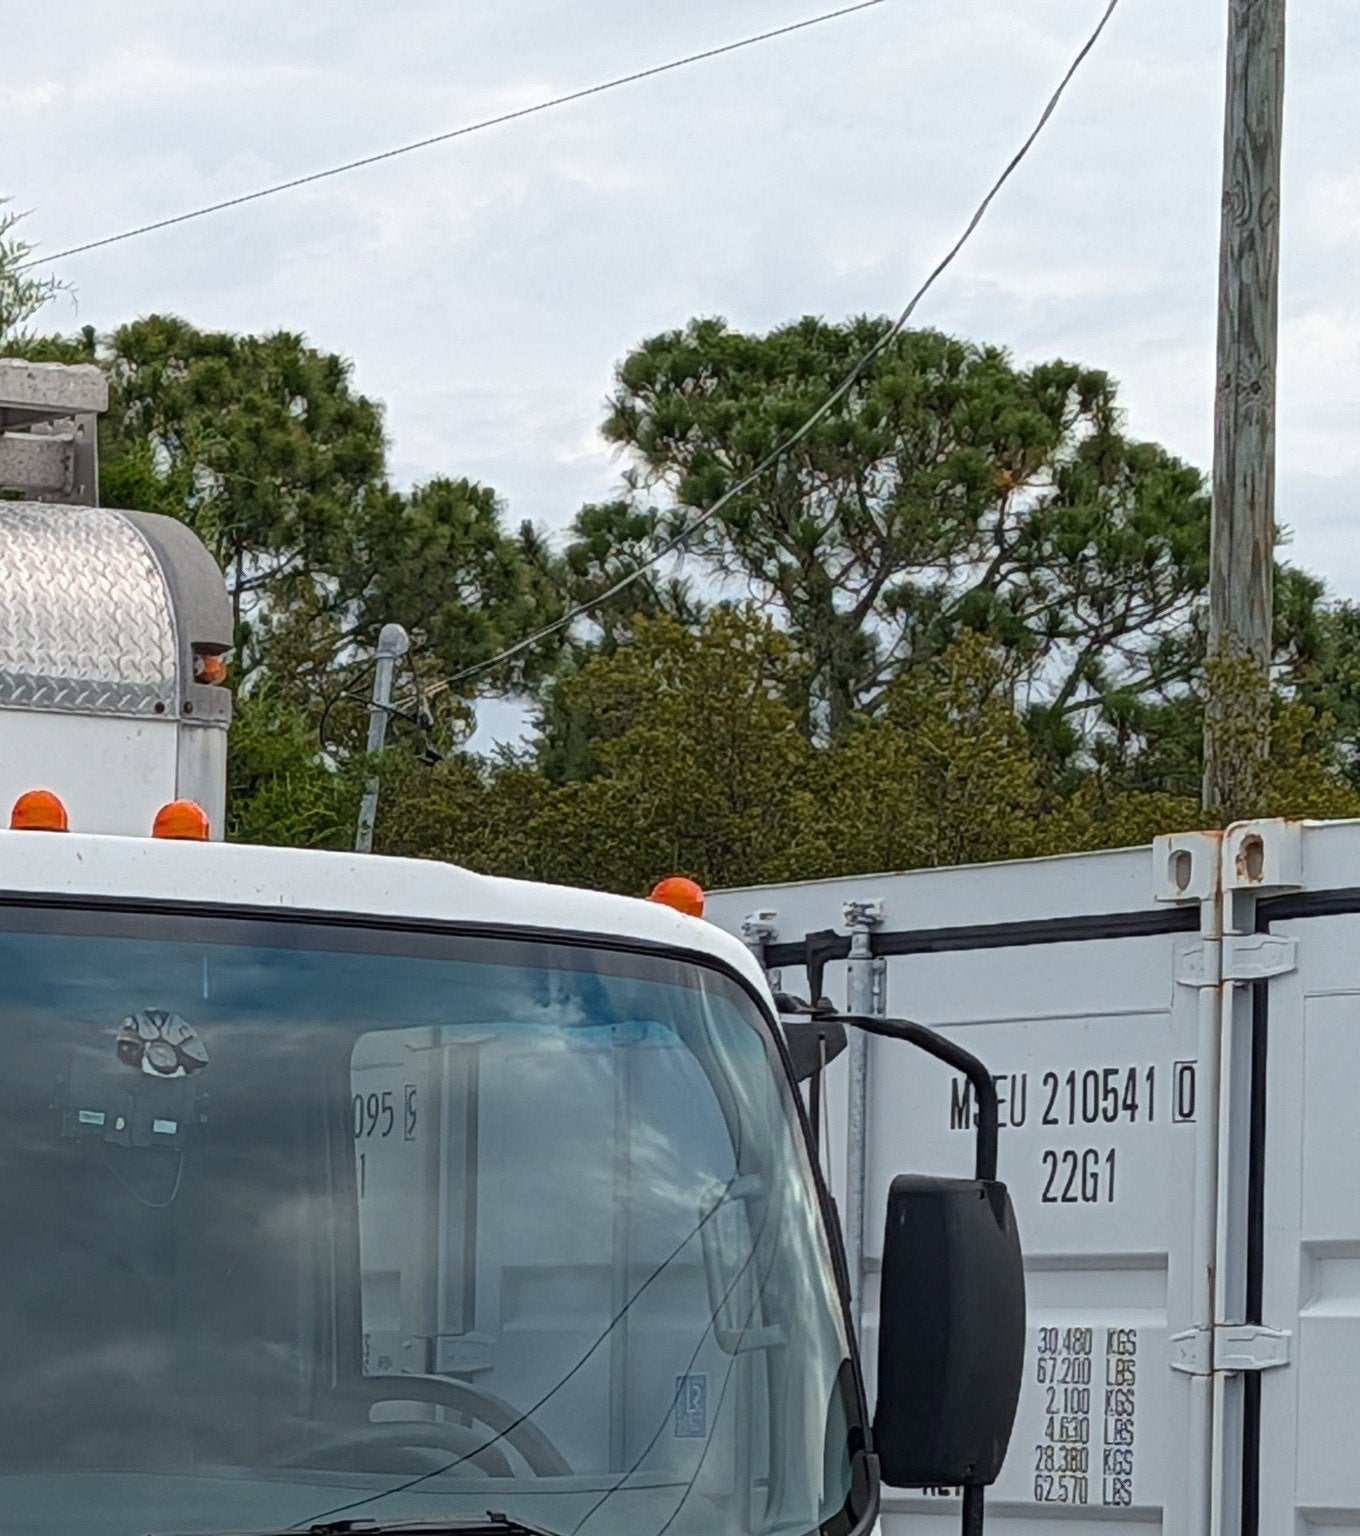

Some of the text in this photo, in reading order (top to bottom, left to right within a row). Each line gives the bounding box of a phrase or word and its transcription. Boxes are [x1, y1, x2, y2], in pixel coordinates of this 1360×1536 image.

[1042, 1066, 1155, 1125] 210541
[1042, 1148, 1116, 1202] 22G1
[1106, 1327, 1137, 1355] KGS
[1106, 1358, 1136, 1386] LBS
[1105, 1388, 1135, 1417] KGS
[1104, 1417, 1134, 1446] LBS
[1103, 1447, 1133, 1475] KGS
[1102, 1477, 1133, 1506] LBS
